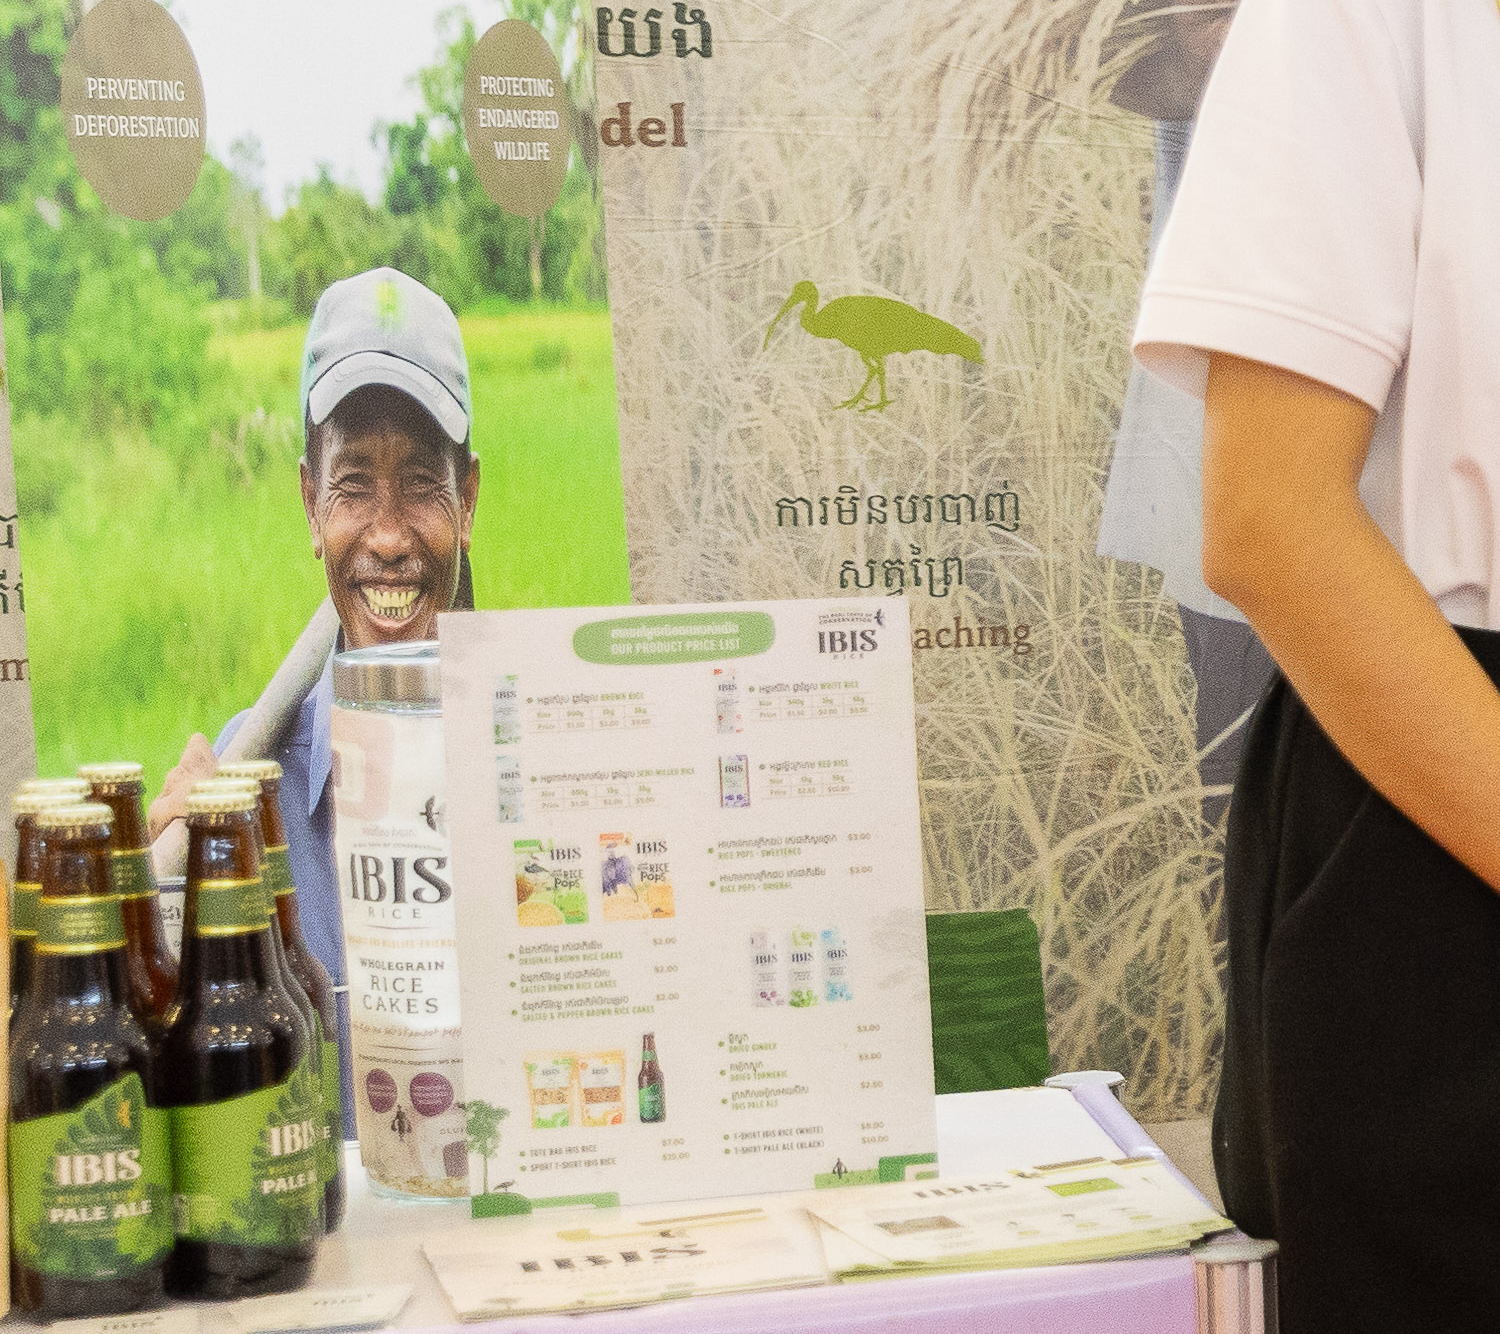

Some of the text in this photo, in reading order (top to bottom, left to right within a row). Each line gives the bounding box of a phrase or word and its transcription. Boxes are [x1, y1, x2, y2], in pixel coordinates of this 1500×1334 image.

[87, 76, 186, 103] PERVENTING
[480, 75, 555, 99] PROTECTING
[74, 113, 200, 140] DEFORESTATION
[479, 108, 560, 131] ENDANGERED
[601, 101, 688, 148] del
[493, 139, 551, 163] WILDLIFE
[611, 638, 741, 655] OUR PRODUCT PRICE LIST
[818, 629, 879, 654] IBIS
[913, 616, 1034, 656] aching
[549, 847, 582, 861] IBIS
[635, 840, 668, 855] IBIS
[350, 851, 452, 904] IBIS
[368, 906, 422, 920] RICE
[359, 957, 445, 972] WHOLEGRAIN
[371, 975, 424, 995] RICE
[362, 995, 440, 1015] CAKES
[778, 1128, 794, 1137] RICE
[763, 1144, 780, 1153] PALE
[782, 1142, 794, 1151] ALE
[54, 1148, 142, 1189] IBIS
[48, 1197, 153, 1223] PALE ALE
